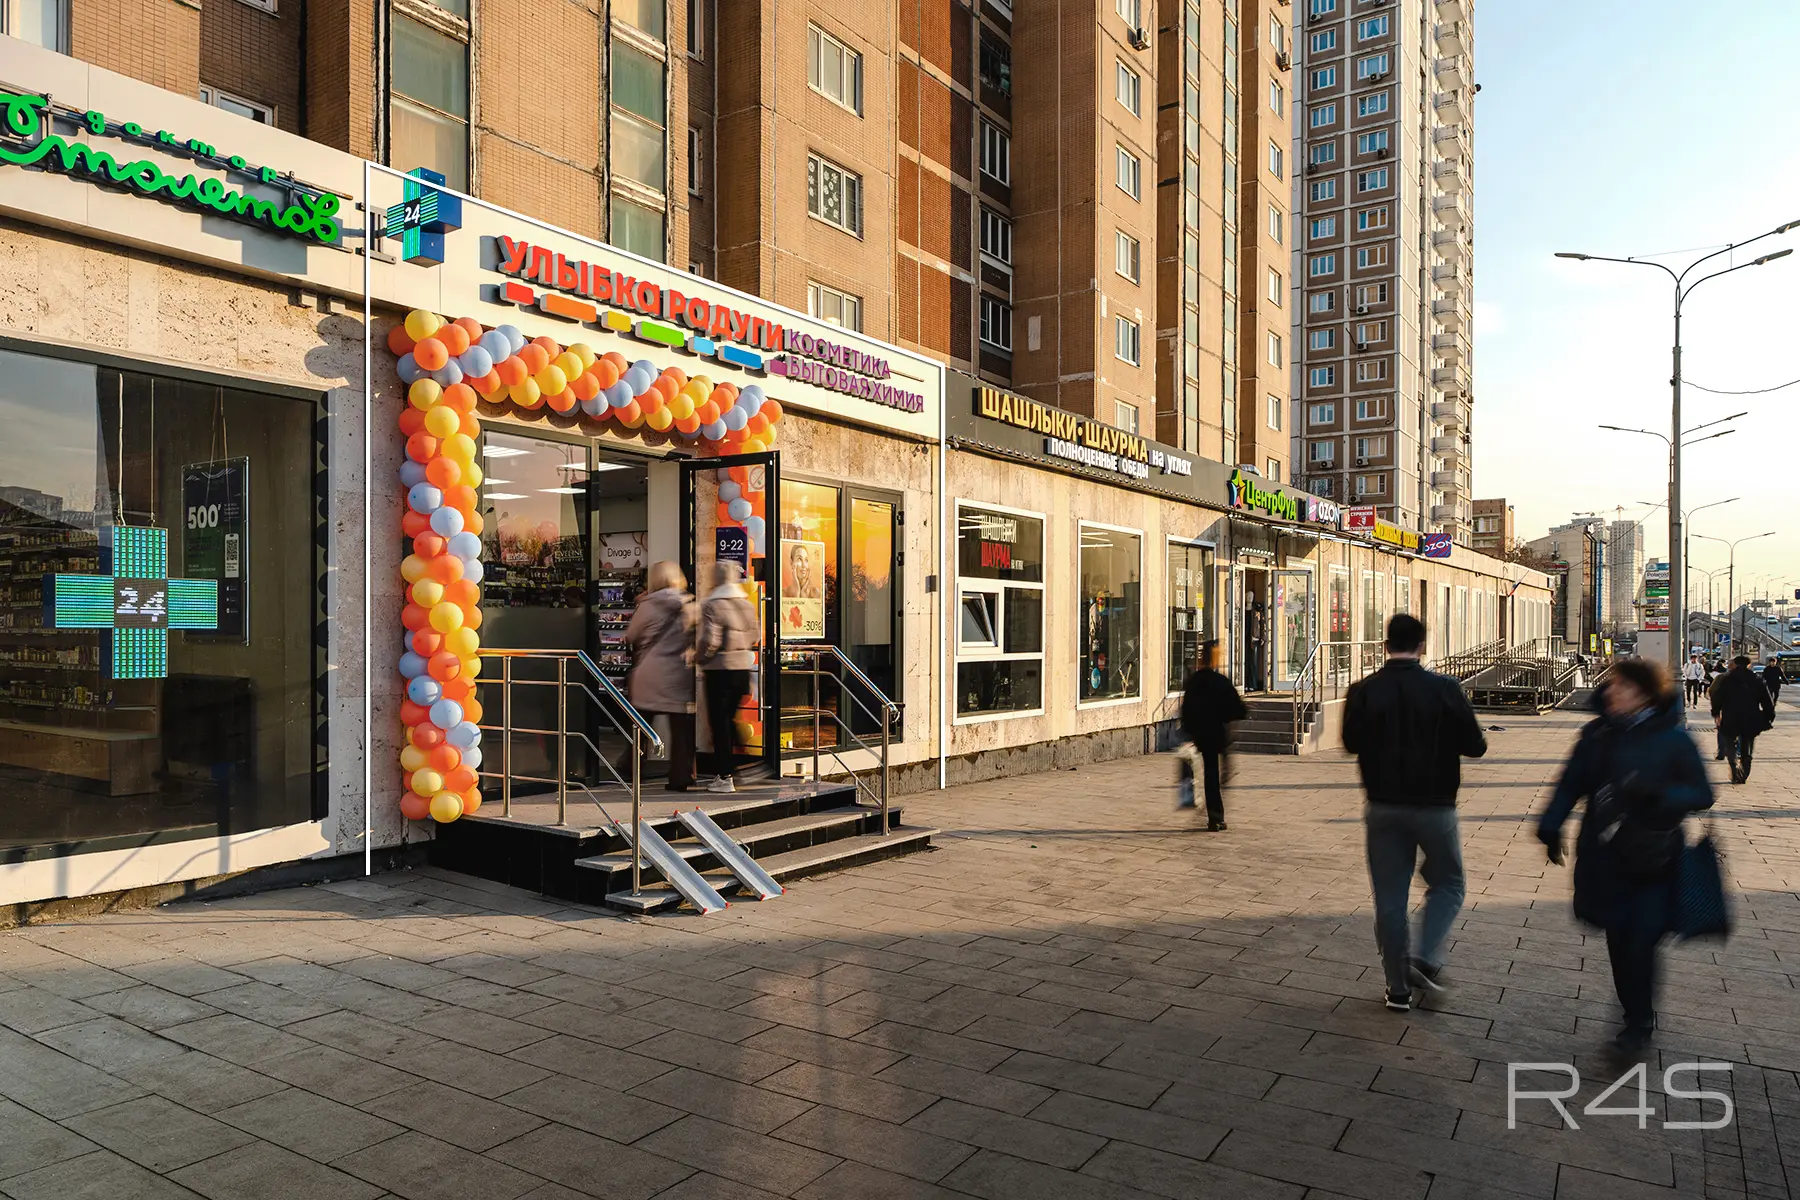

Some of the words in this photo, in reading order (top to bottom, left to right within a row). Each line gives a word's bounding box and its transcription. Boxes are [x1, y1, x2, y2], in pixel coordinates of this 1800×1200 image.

[404, 204, 421, 225] 24
[789, 329, 892, 381] КОСМЕТИКА
[788, 355, 873, 398] БЫТОВАЯ
[873, 380, 925, 413] ХИМИЯ
[981, 386, 1077, 442] ШАШЛЫКИ
[1085, 421, 1149, 462] ШАУРМА
[1051, 438, 1118, 471] ПОЛНОЦЕННЫЕ
[1122, 459, 1149, 479] ОБЕДЫ
[1246, 479, 1297, 521] ЦентрФуд
[1318, 501, 1340, 523] OZON
[607, 547, 632, 560] Divage
[719, 539, 744, 551] 9-22
[1424, 539, 1453, 553] OZON
[116, 587, 166, 622] 24
